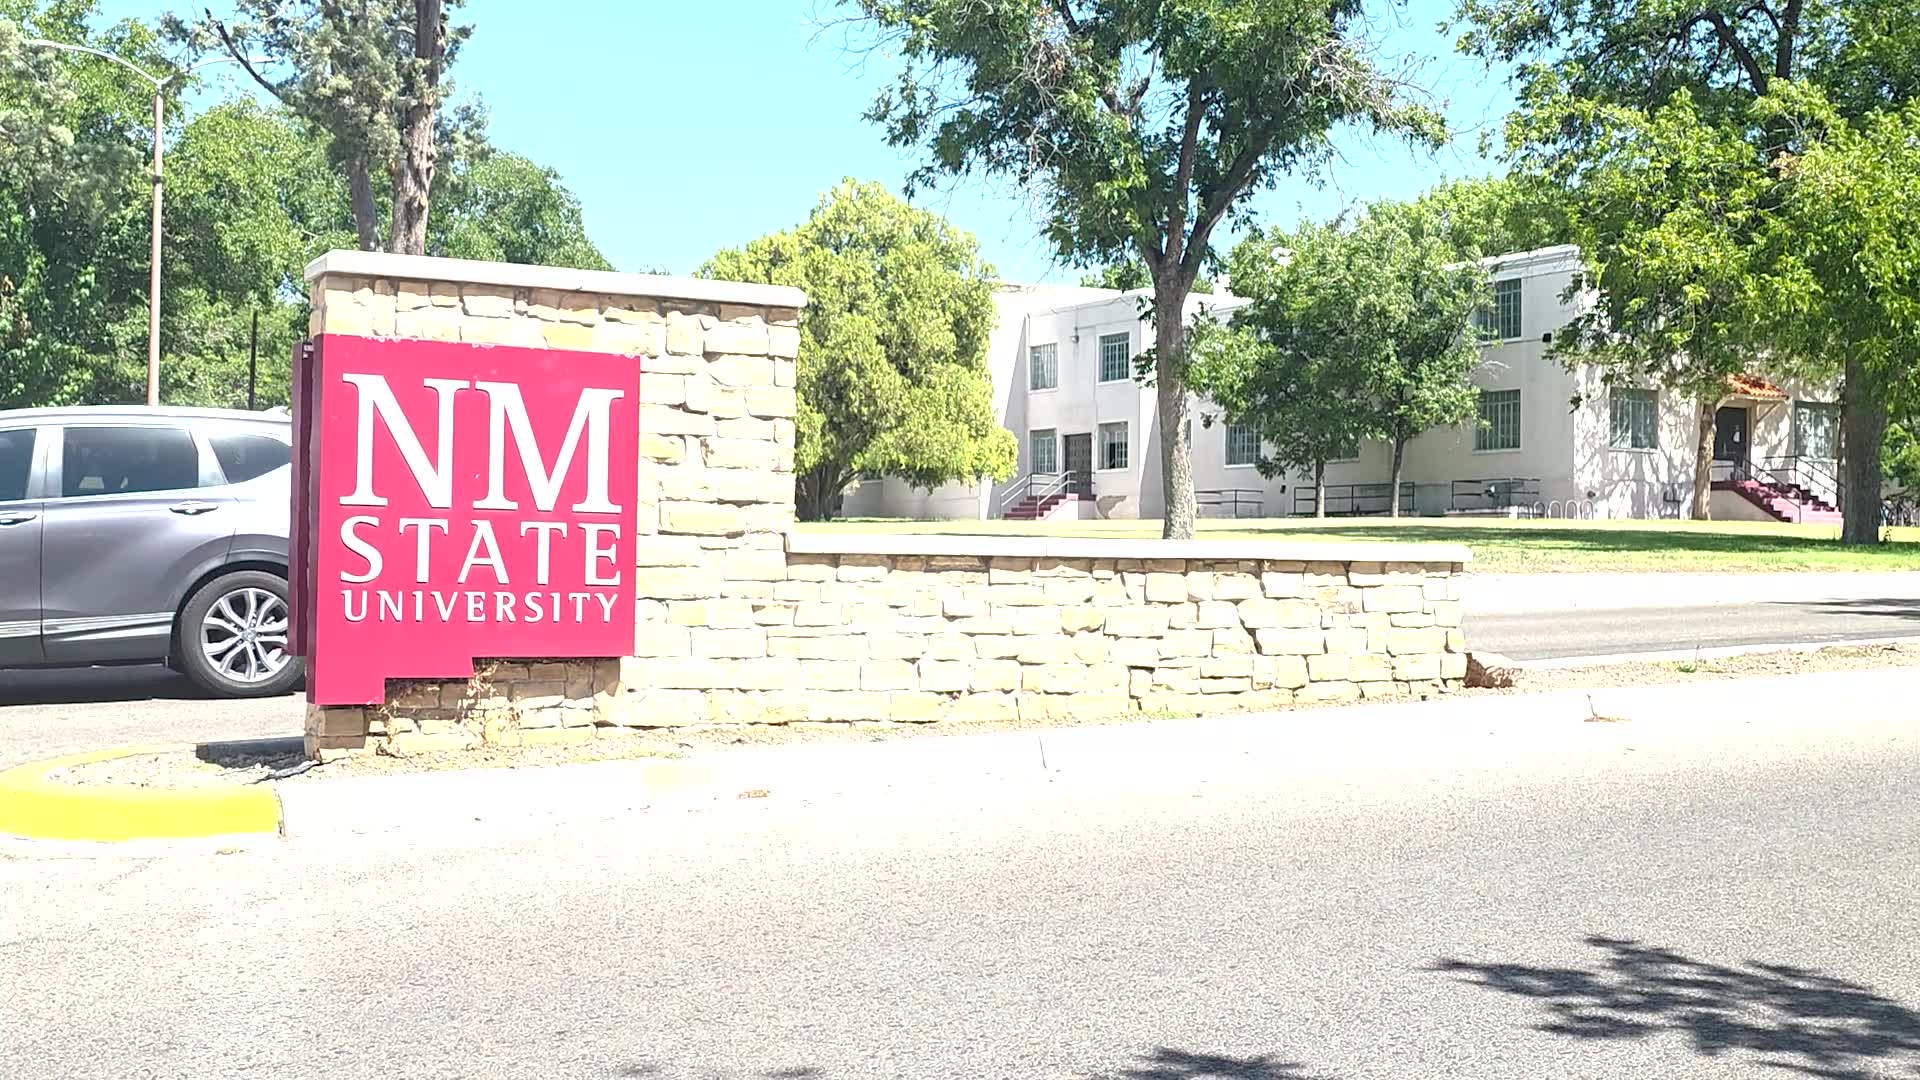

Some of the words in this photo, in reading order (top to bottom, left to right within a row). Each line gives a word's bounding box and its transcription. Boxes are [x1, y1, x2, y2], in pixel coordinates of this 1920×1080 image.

[339, 372, 625, 514] NM
[340, 515, 621, 586] STATE
[341, 589, 619, 623] UNIVERSITY
